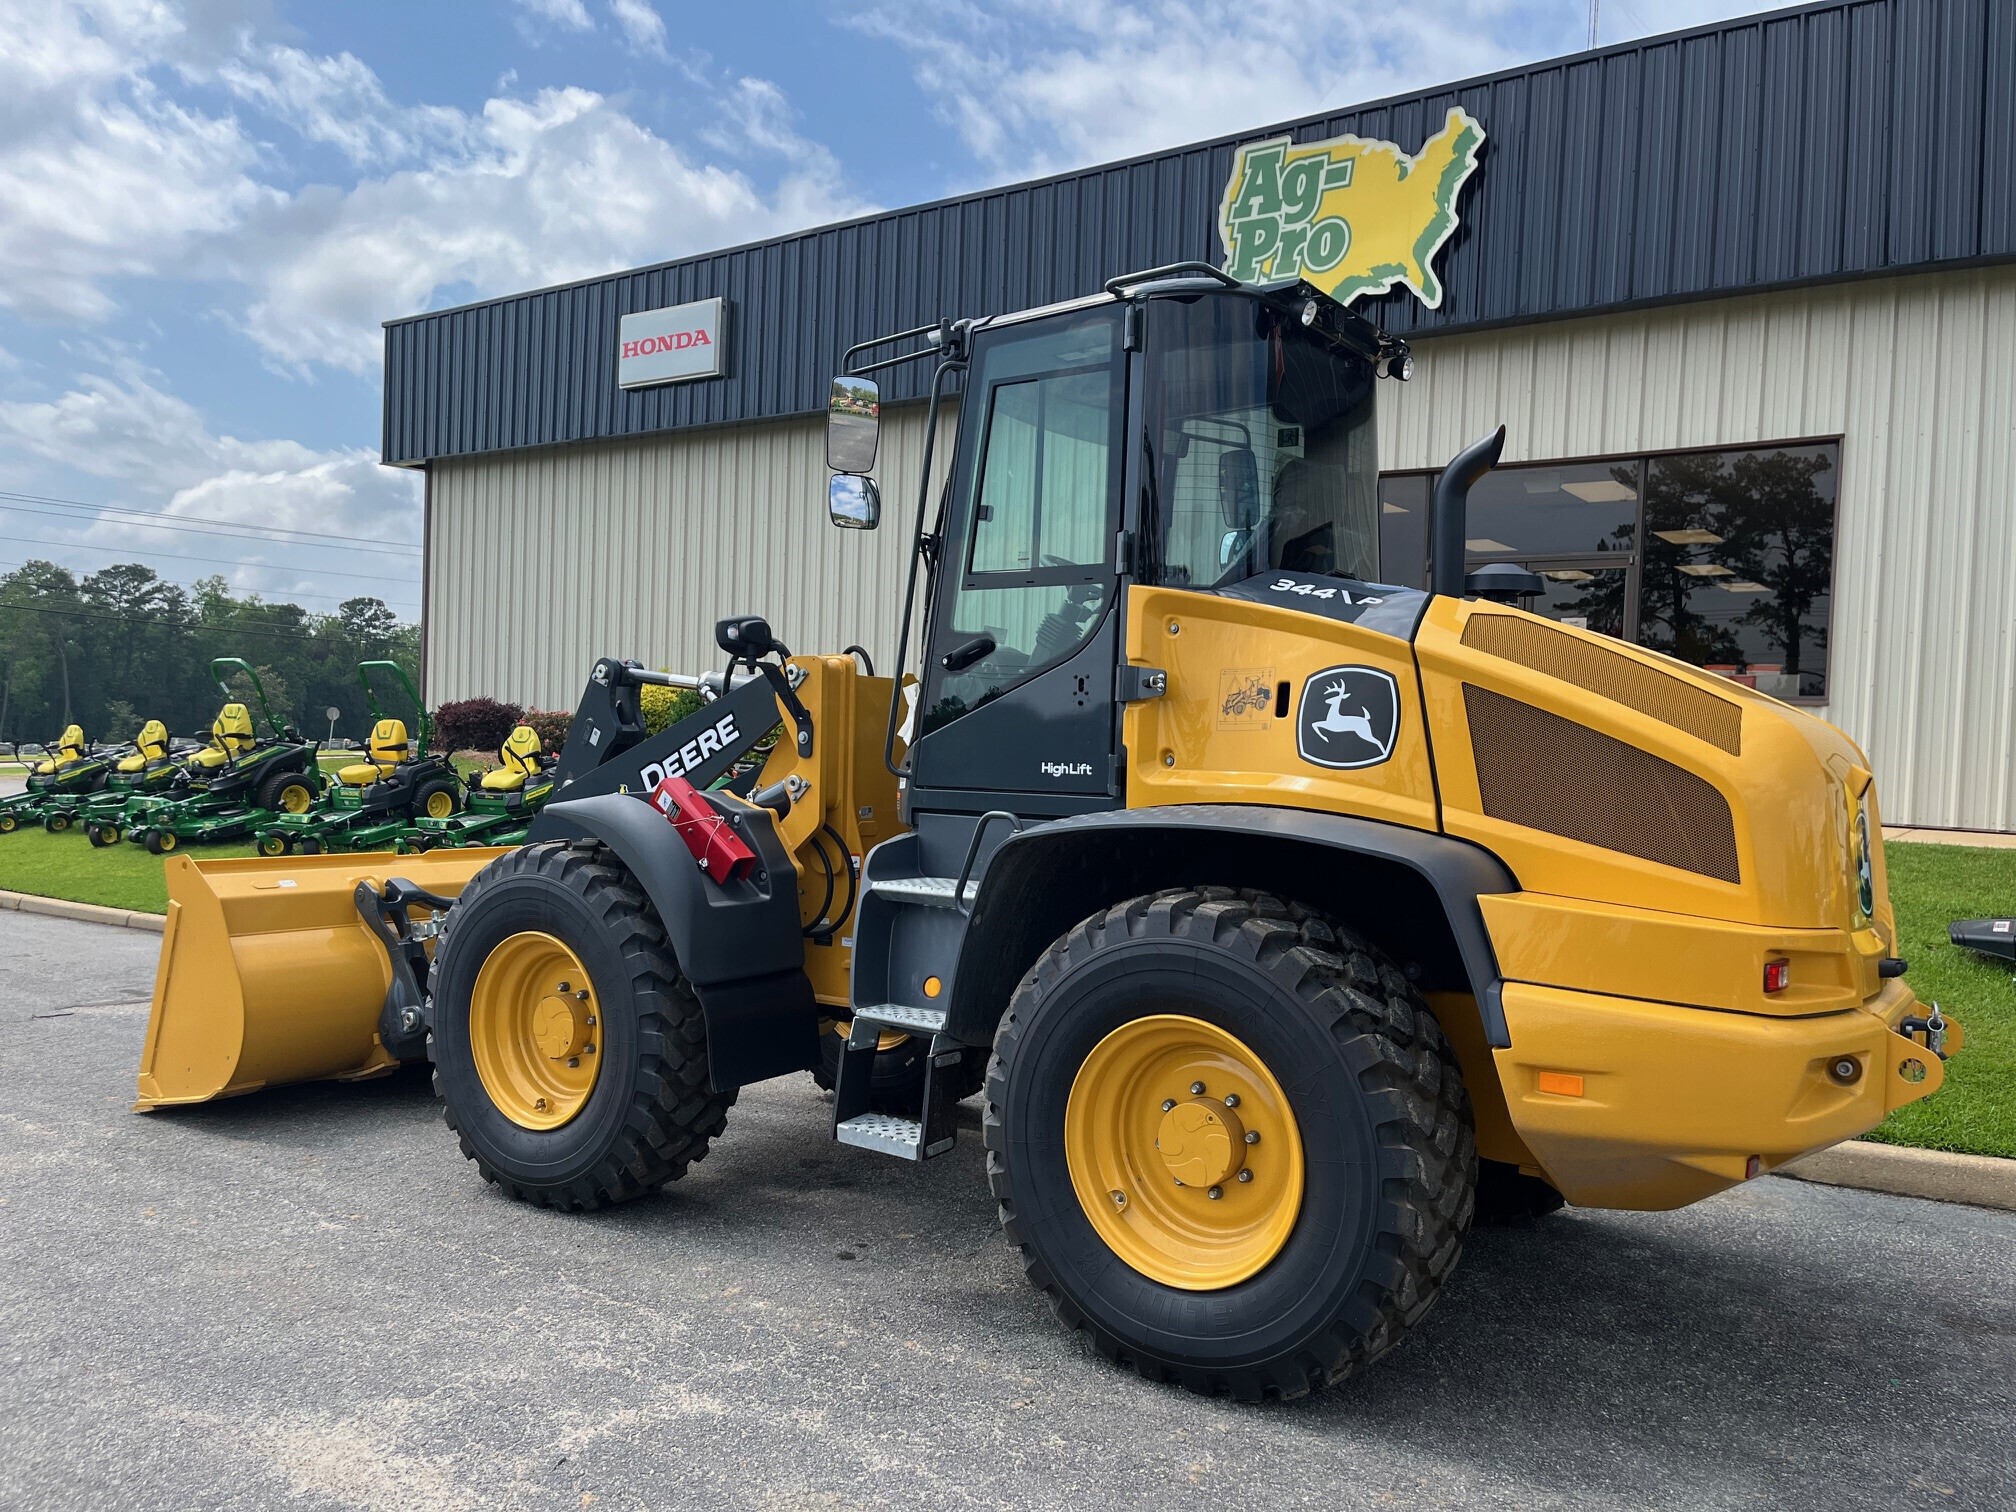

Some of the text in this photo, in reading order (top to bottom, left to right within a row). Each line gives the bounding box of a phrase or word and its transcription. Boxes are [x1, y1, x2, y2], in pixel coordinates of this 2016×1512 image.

[1226, 142, 1355, 227] Ag-
[1229, 215, 1352, 284] Pro
[622, 329, 711, 358] HONDA
[640, 713, 740, 791] DEERE
